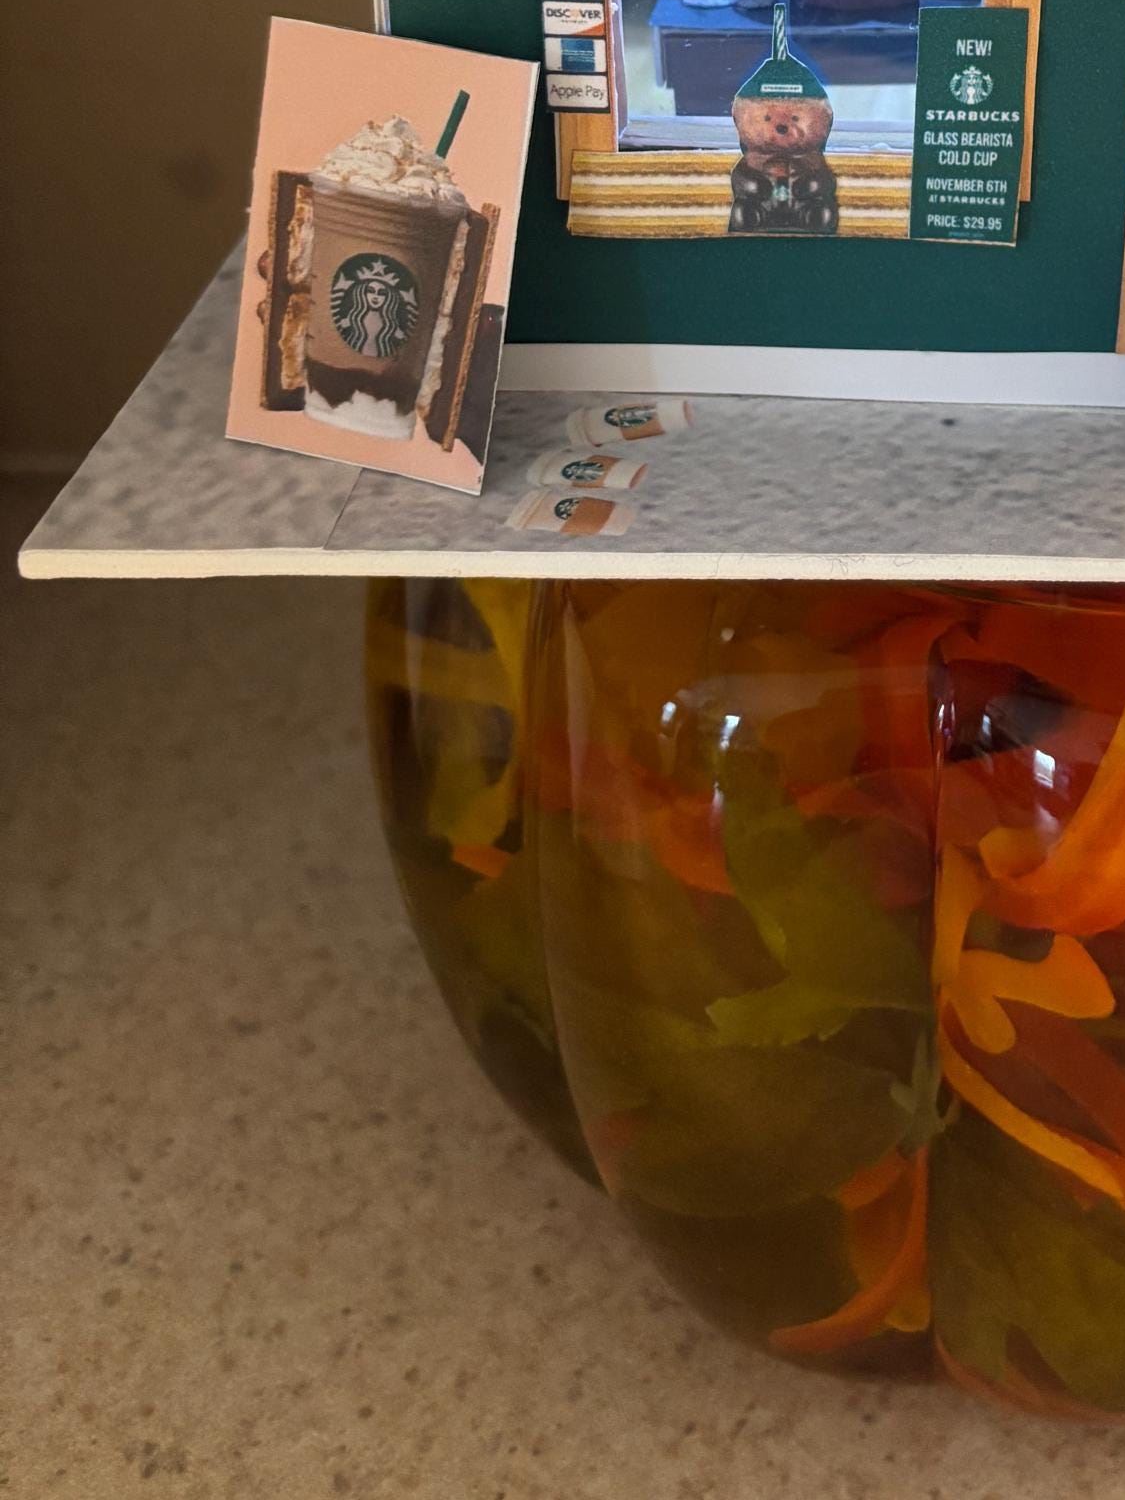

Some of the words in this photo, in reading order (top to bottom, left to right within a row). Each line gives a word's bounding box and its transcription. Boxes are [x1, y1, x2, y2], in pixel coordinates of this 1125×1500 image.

[956, 39, 993, 56] NEW!
[550, 83, 583, 99] Apple
[585, 85, 604, 100] Pay
[925, 109, 1020, 122] STARBUCKS
[923, 131, 959, 147] GLASS
[960, 132, 1013, 147] BEARISTA
[938, 151, 971, 167] COLD
[973, 152, 999, 168] CUP
[926, 178, 984, 194] NOVEMBER
[985, 180, 1008, 195] 6TH
[939, 195, 1006, 206] STARBUCKS
[927, 214, 961, 229] PRICE:
[963, 216, 1003, 231] $29.95
